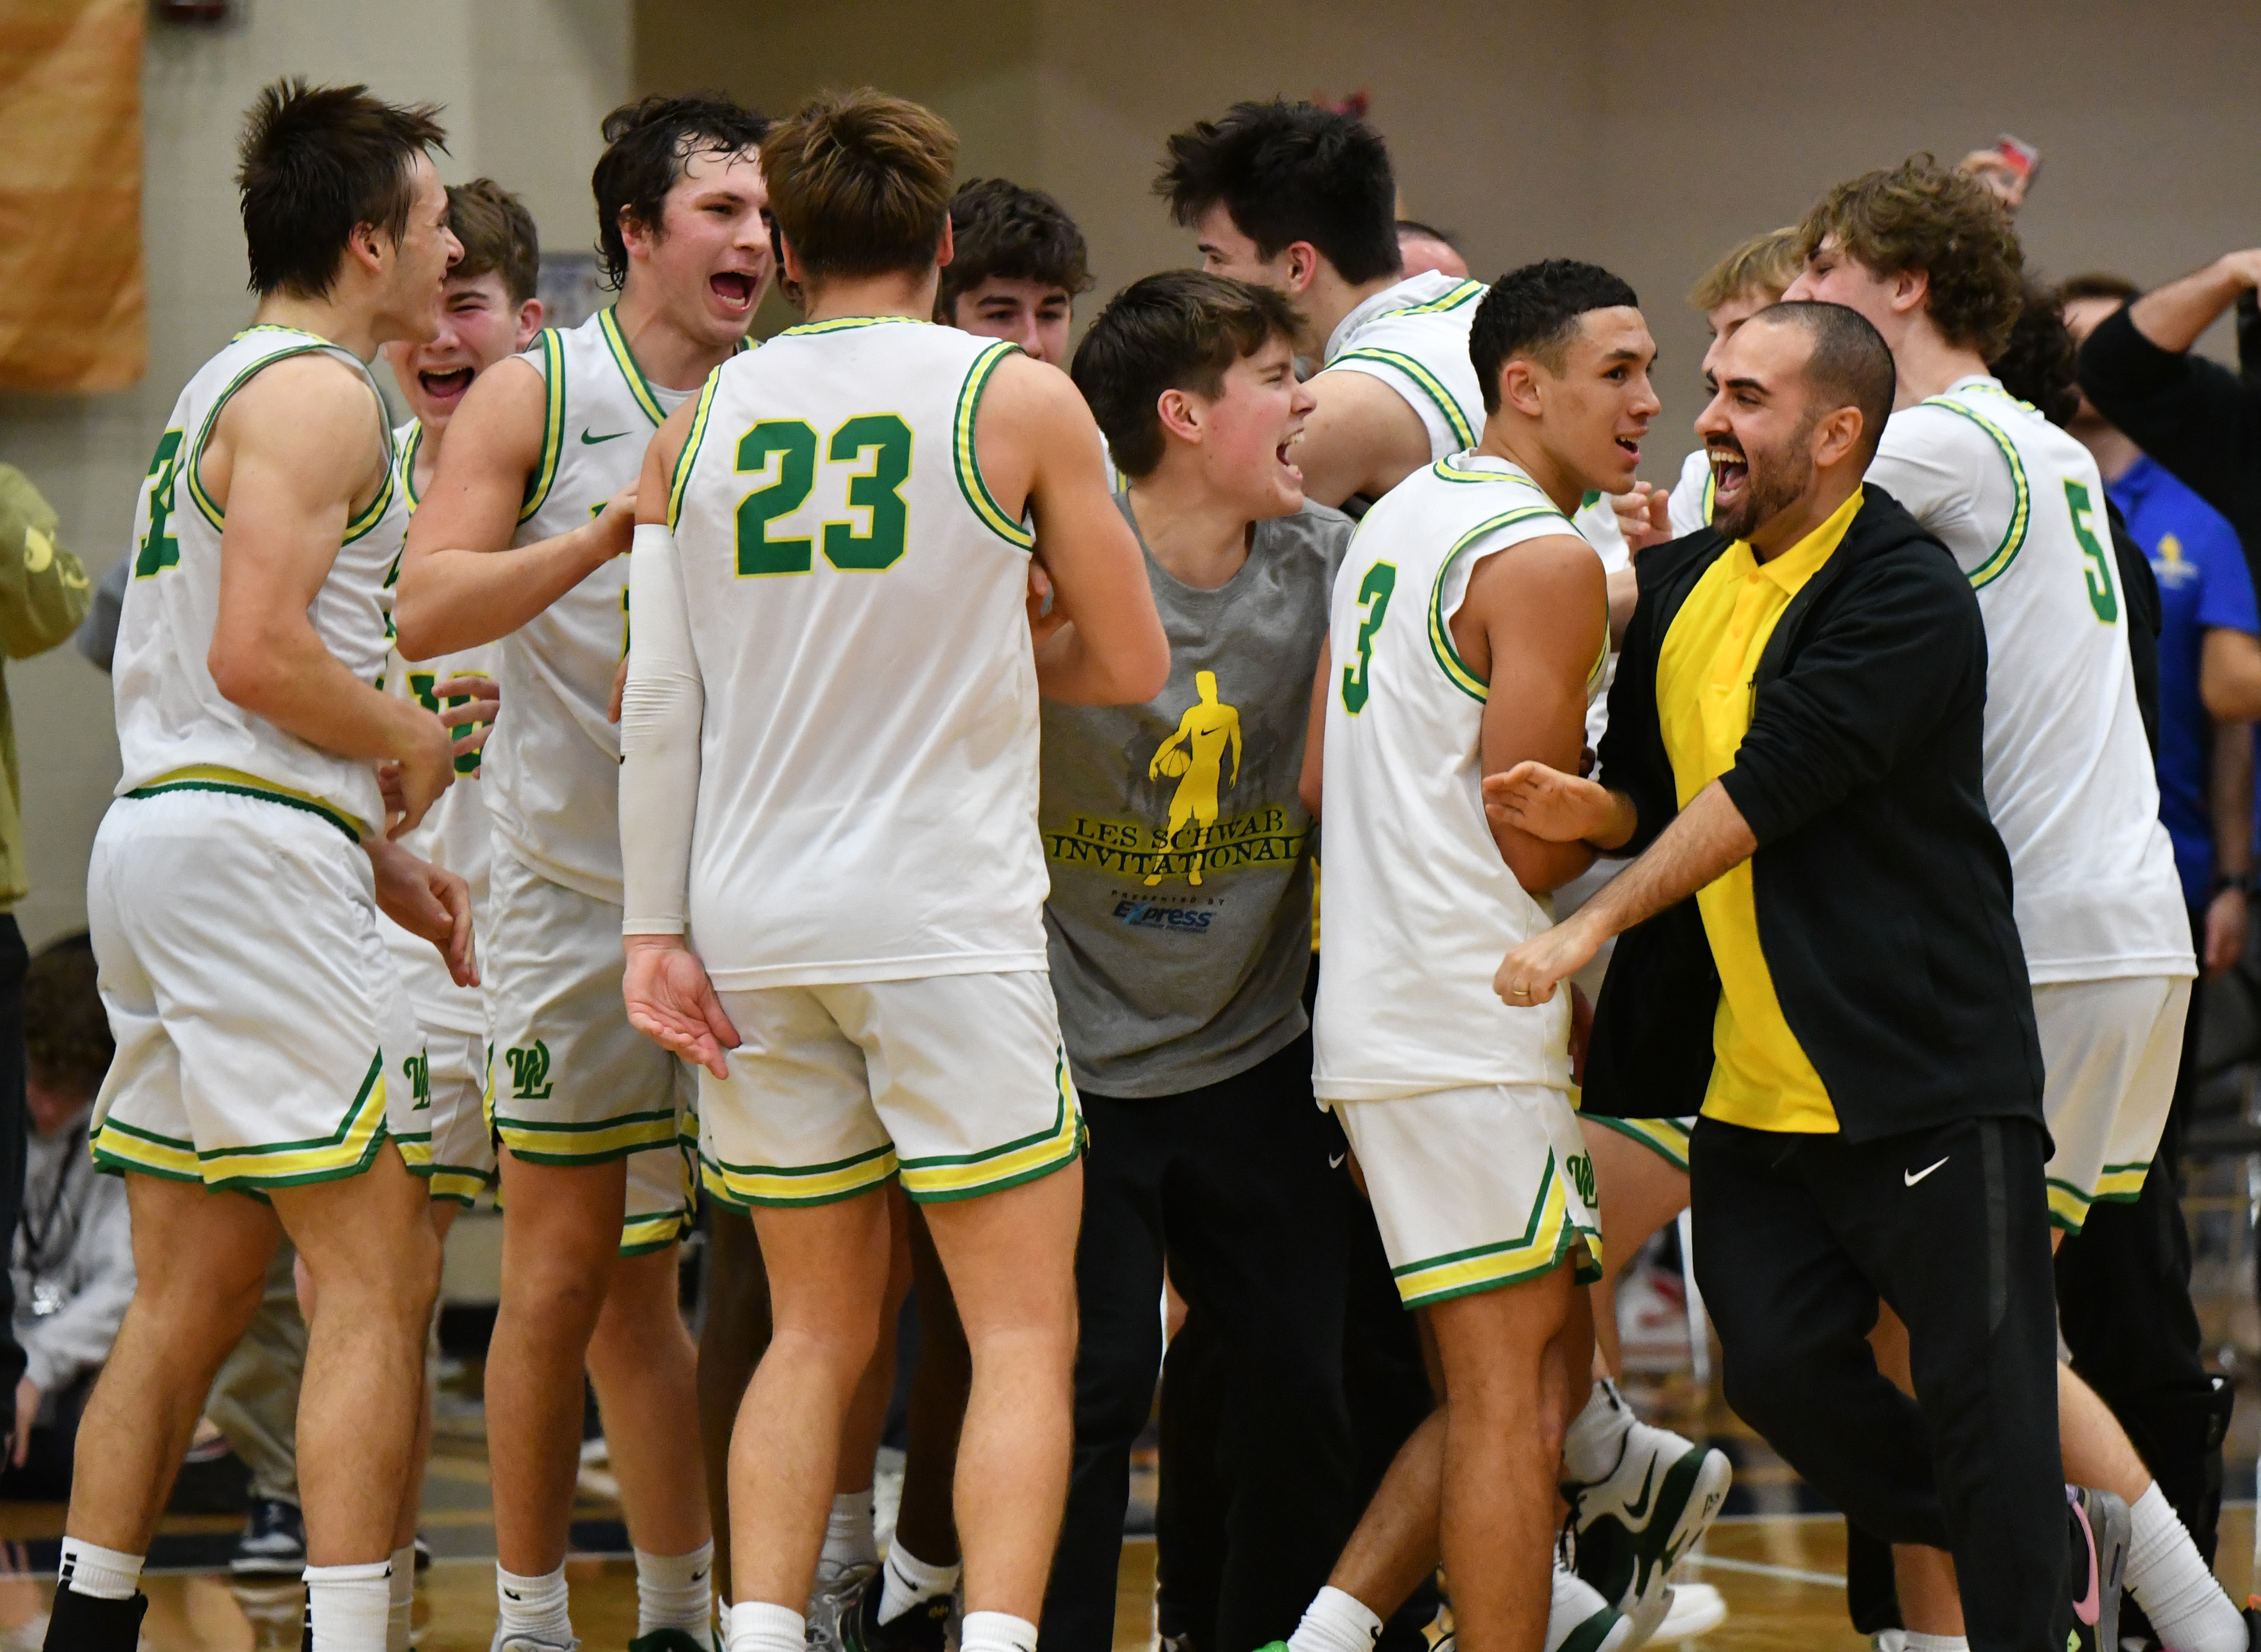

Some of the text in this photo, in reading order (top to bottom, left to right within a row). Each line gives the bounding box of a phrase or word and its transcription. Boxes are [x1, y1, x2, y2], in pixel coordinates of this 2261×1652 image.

[732, 411, 915, 579] 23
[2062, 477, 2118, 626] 5
[1340, 558, 1397, 718] 3
[1052, 835, 1300, 875] INVITATIONAL
[1076, 809, 1283, 850] LES SCHWAB
